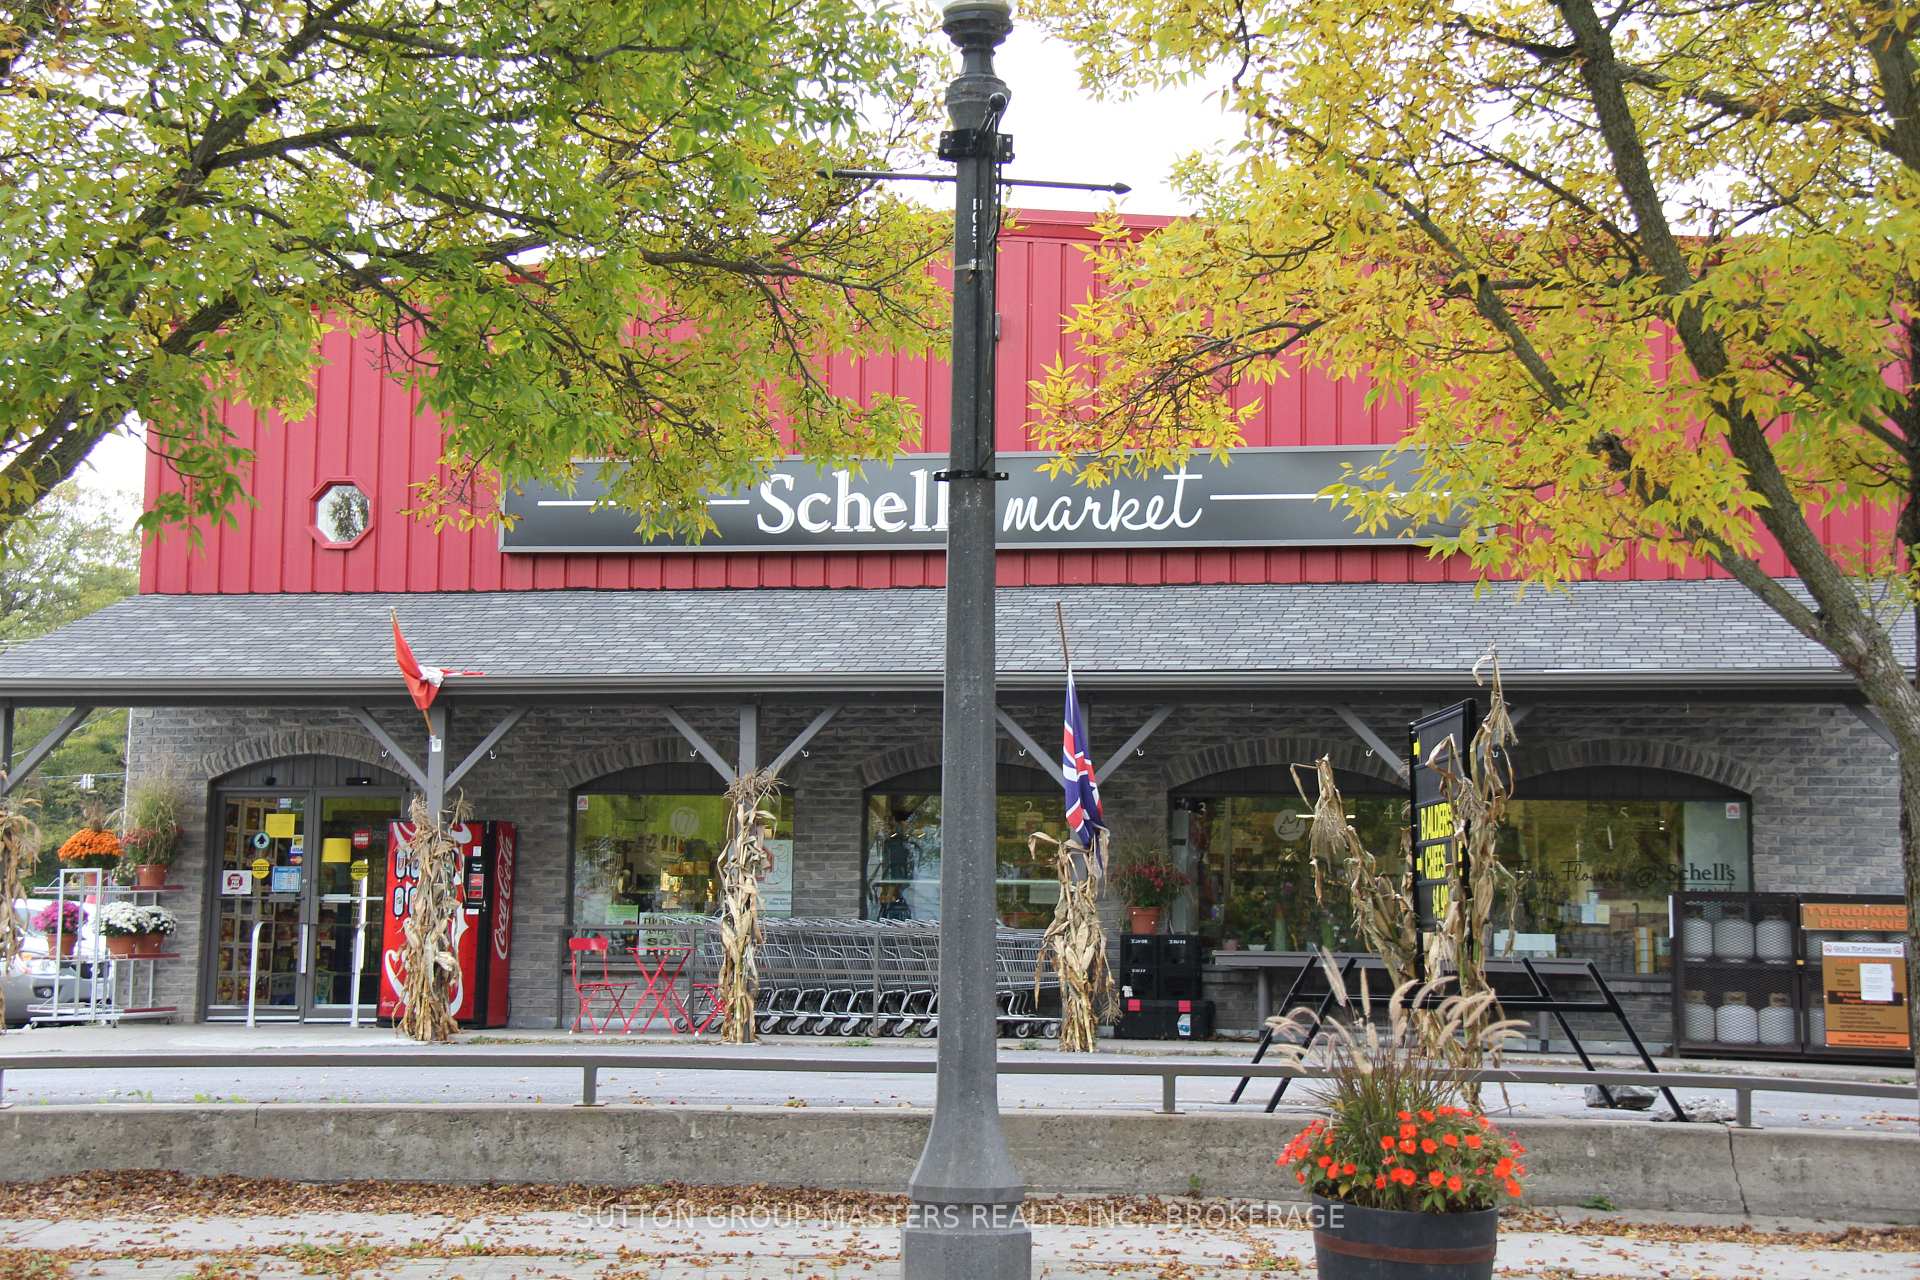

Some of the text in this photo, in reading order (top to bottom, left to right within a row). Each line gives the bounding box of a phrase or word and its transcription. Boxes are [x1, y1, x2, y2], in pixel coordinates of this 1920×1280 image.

[1003, 463, 1203, 532] market
[1421, 802, 1454, 841] BALDERS
[1665, 863, 1735, 881] Schell's
[1819, 918, 1905, 929] PROPANE
